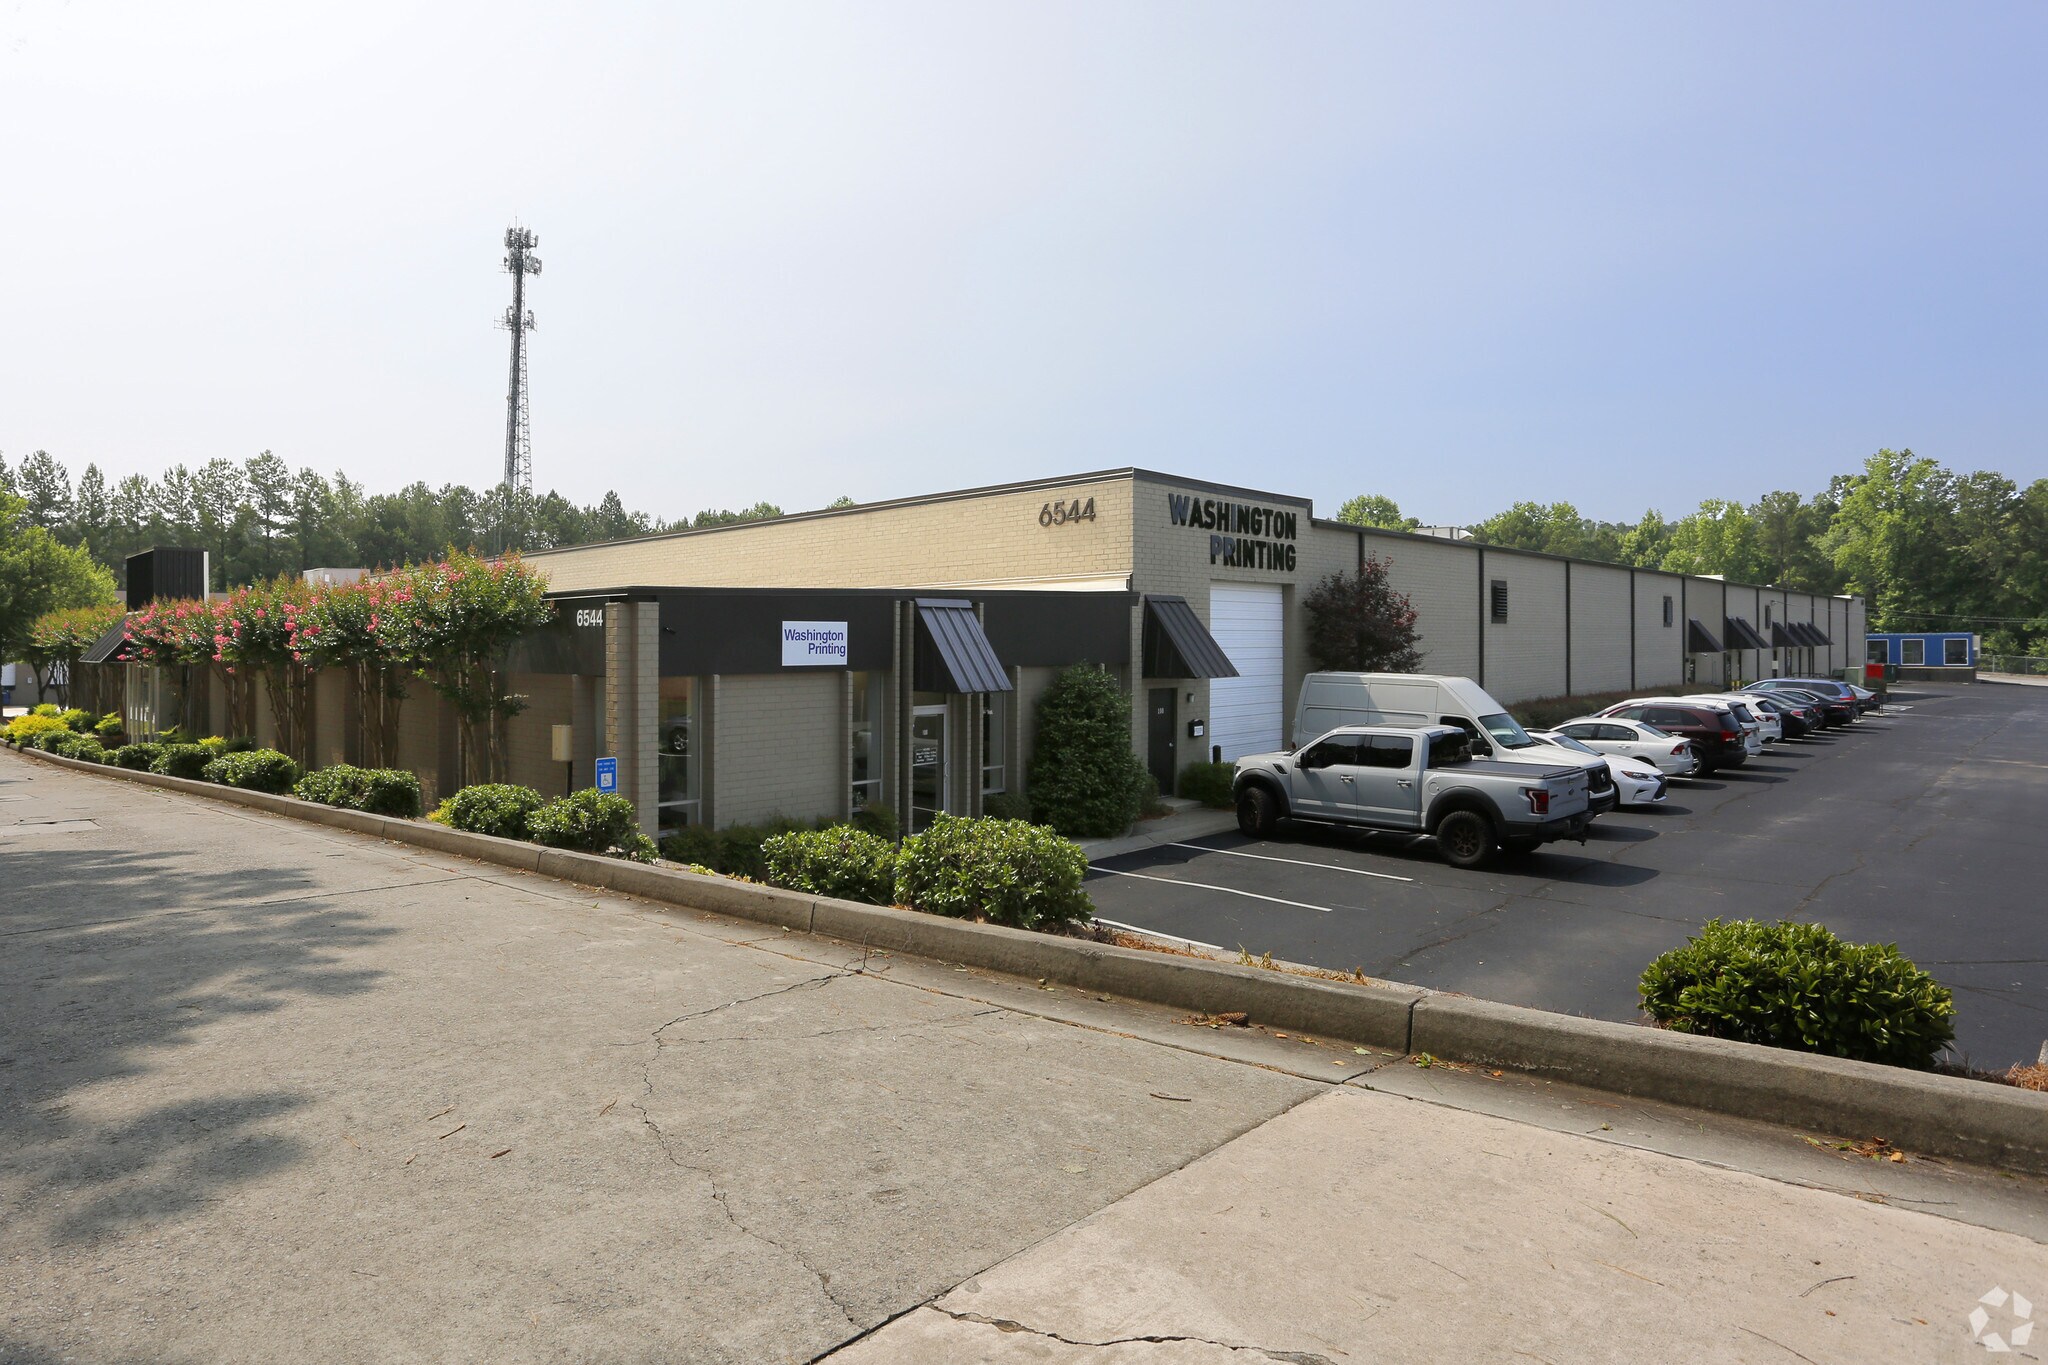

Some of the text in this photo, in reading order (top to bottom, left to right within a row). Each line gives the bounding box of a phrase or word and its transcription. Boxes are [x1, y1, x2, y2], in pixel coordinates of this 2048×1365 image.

[1038, 497, 1096, 527] 6544
[1168, 493, 1297, 540] WASHINGTON
[1210, 534, 1297, 572] PRINTING
[576, 609, 603, 627] 6544
[784, 629, 844, 644] Washington
[808, 643, 846, 657] Printing
